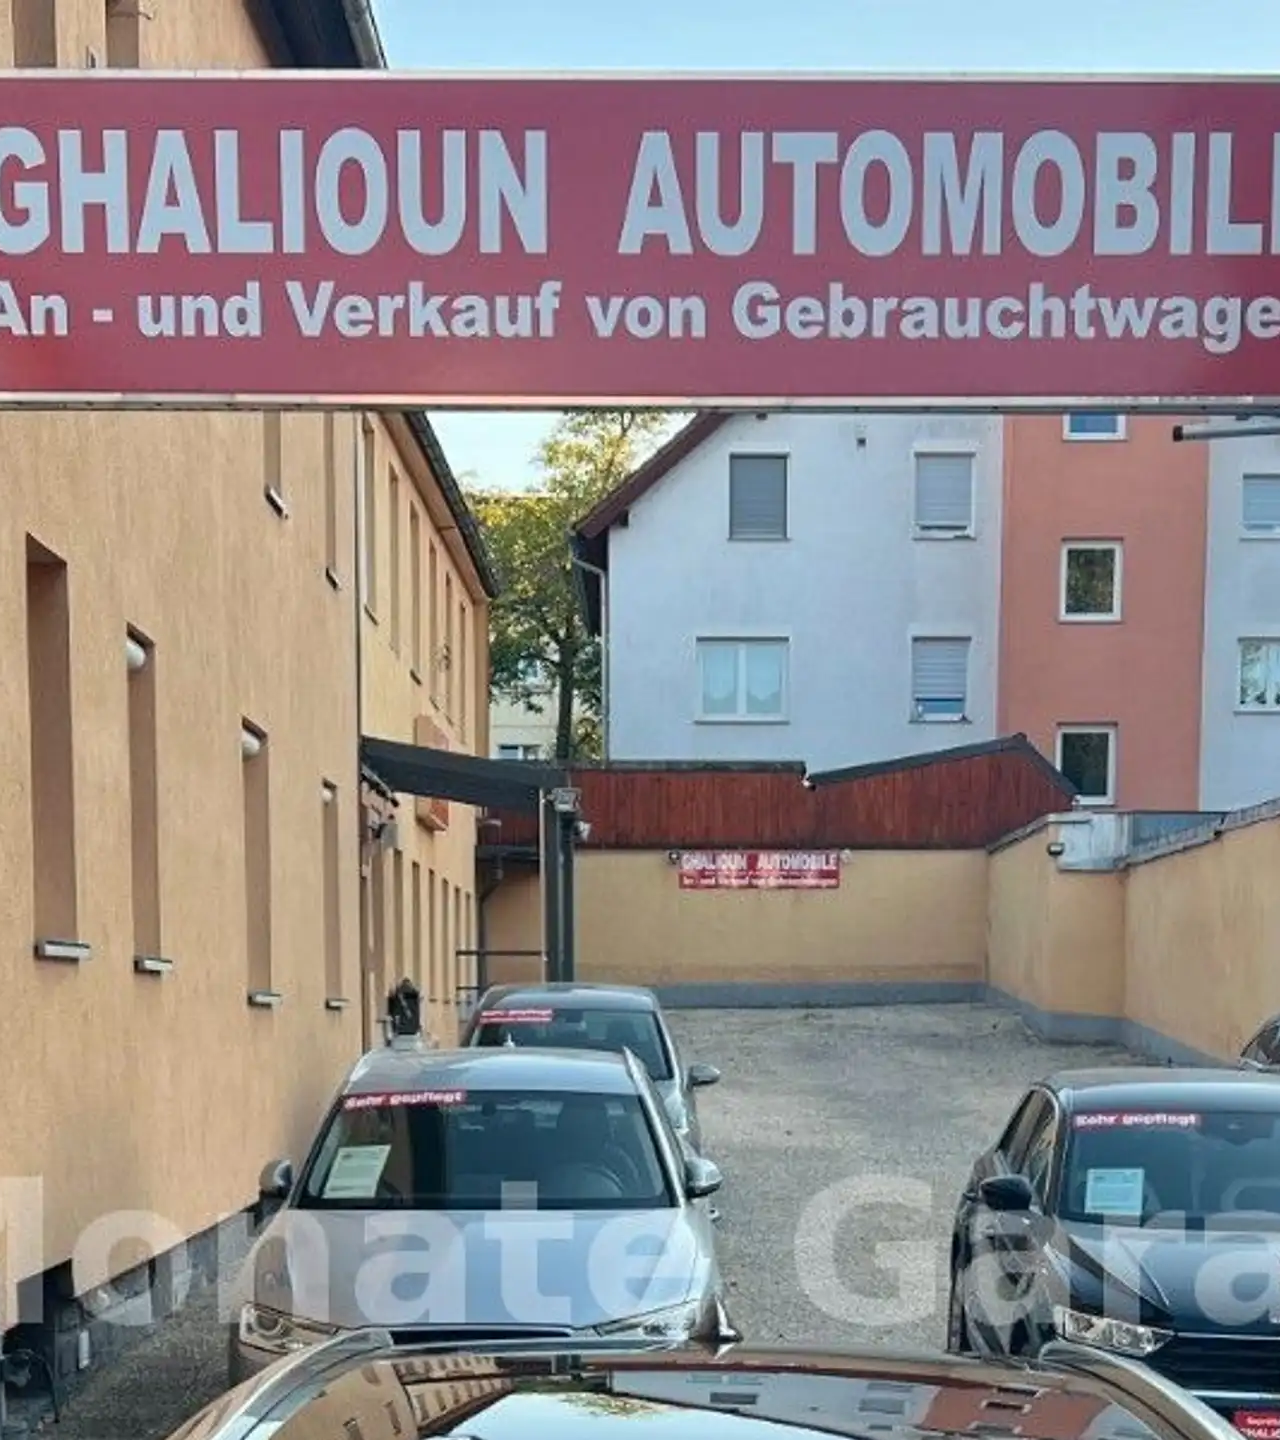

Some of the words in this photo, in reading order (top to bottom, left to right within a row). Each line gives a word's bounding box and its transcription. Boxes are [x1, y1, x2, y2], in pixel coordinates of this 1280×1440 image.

[138, 281, 263, 339] und
[286, 281, 563, 339] Verkauf
[586, 296, 707, 340] von
[757, 853, 837, 870] AUTOMOBILE
